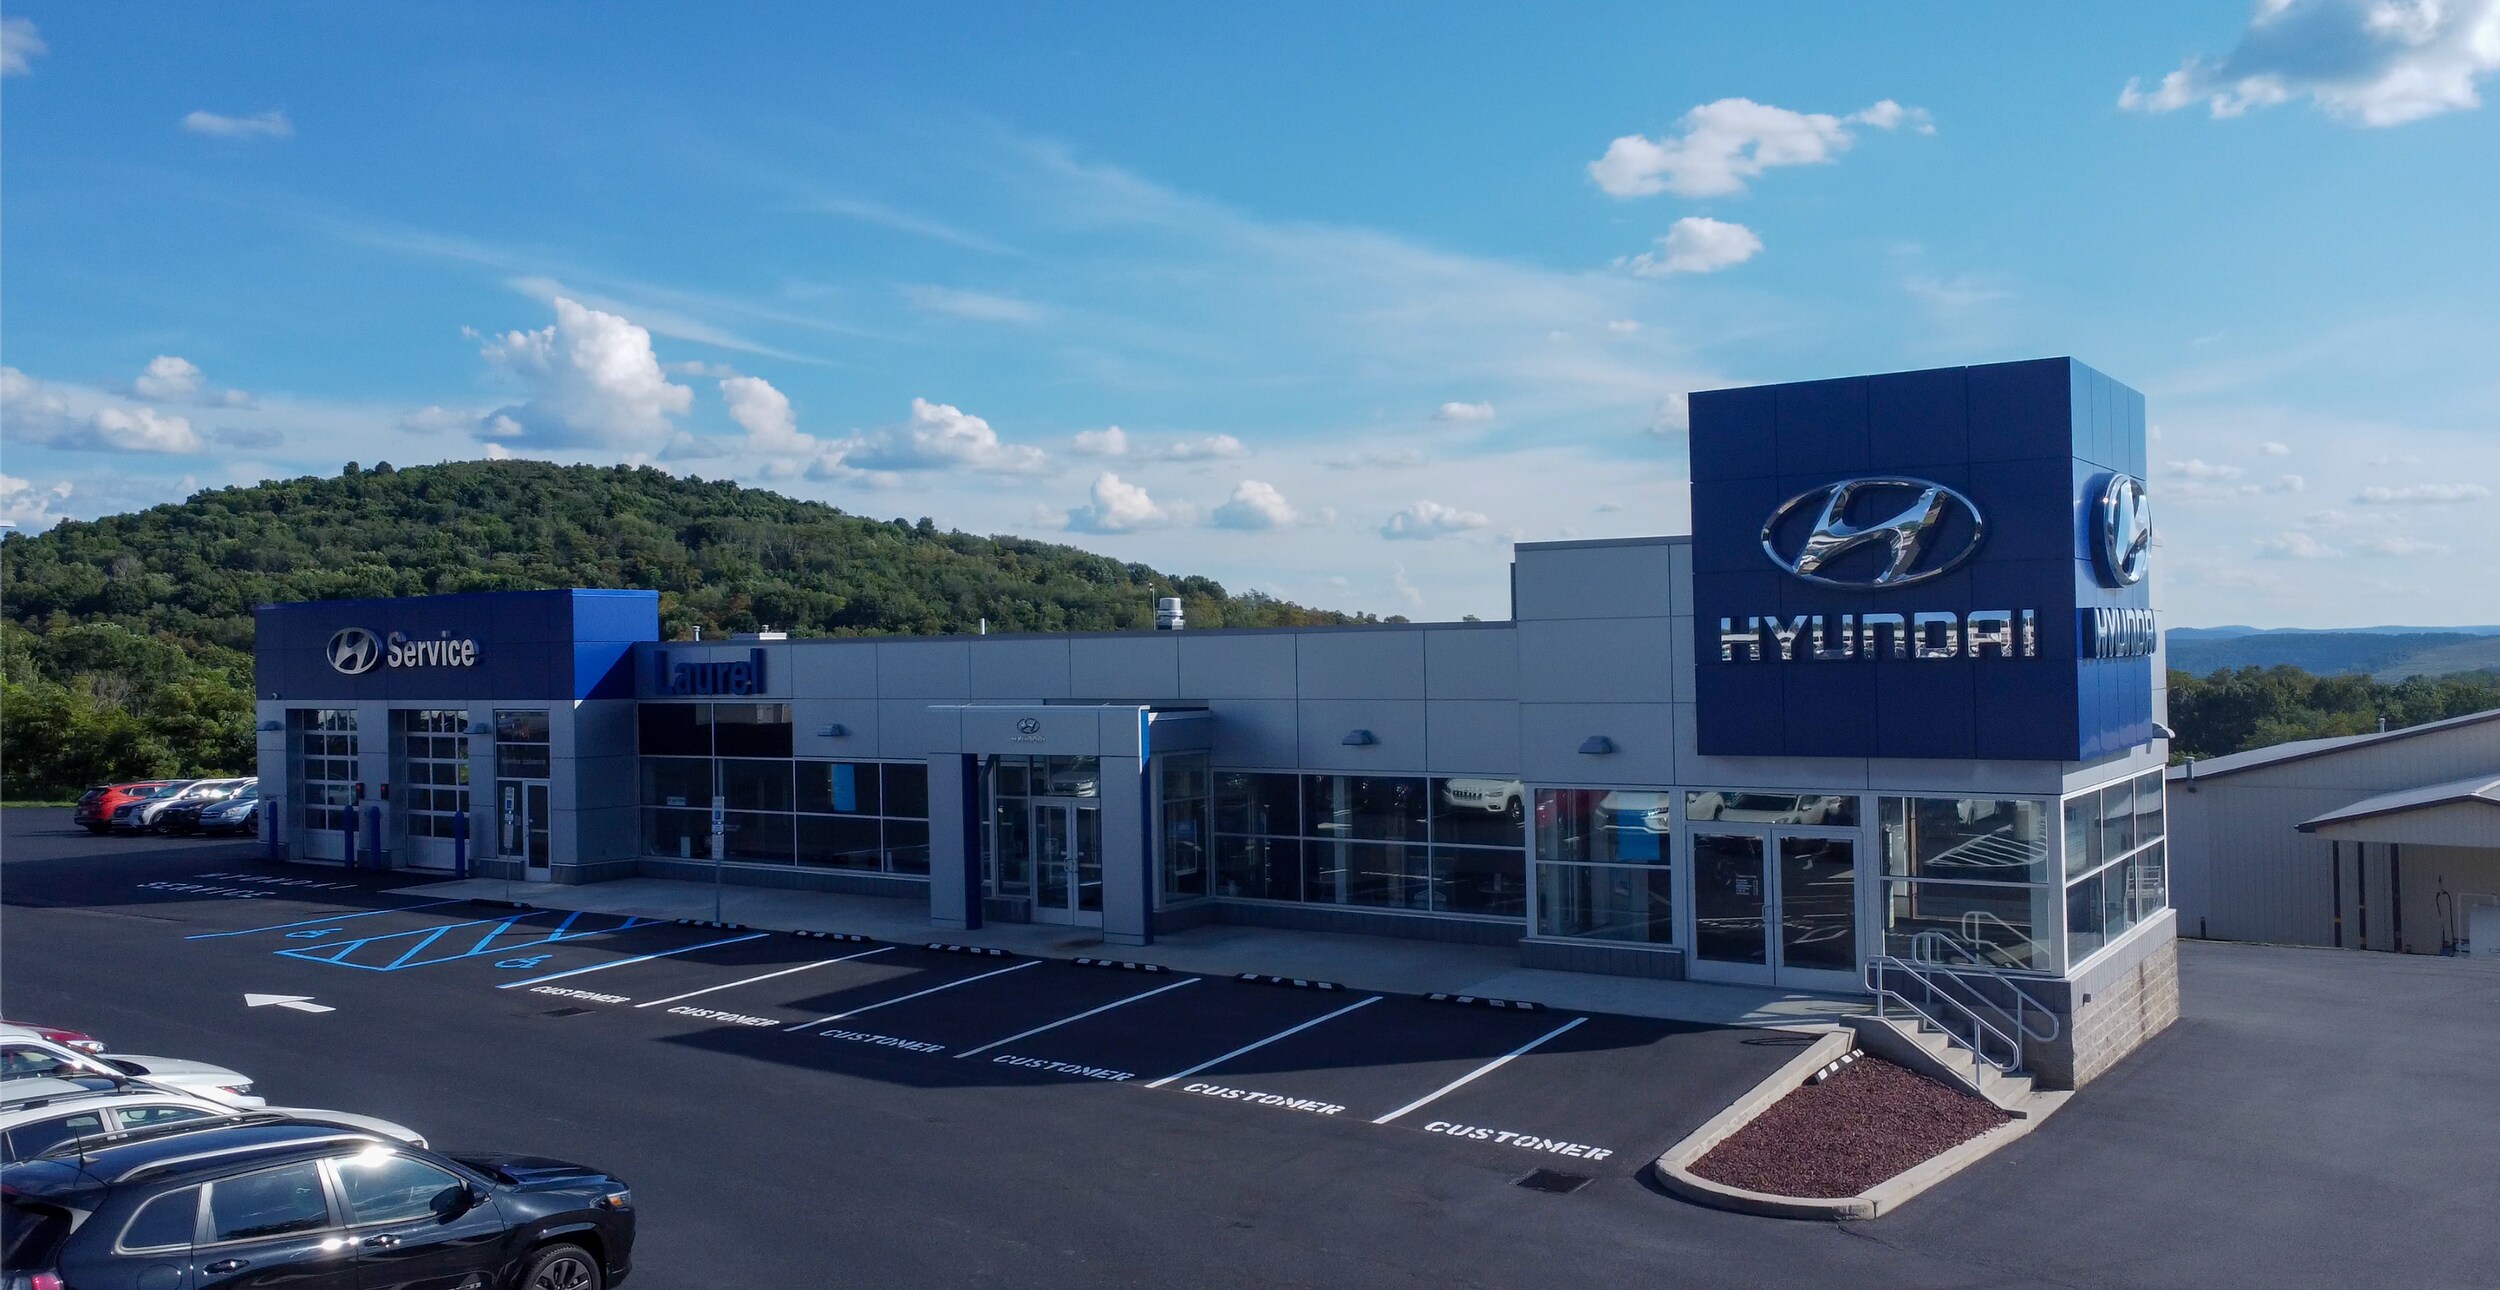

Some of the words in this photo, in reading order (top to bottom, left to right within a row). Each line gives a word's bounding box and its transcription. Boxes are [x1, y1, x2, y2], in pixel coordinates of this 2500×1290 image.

[387, 630, 479, 668] Service
[1720, 608, 2036, 661] HYUNDAI
[654, 648, 768, 696] Laurel
[136, 881, 276, 898] SERVICE
[529, 985, 631, 1004] CUSTOMER
[667, 1006, 780, 1028] CUSTOMER
[819, 1029, 946, 1053] CUSTOMER
[992, 1054, 1136, 1083] CUSTOMER
[1183, 1083, 1346, 1116] CUSTOMER
[1424, 1121, 1614, 1161] CUSTOMER
